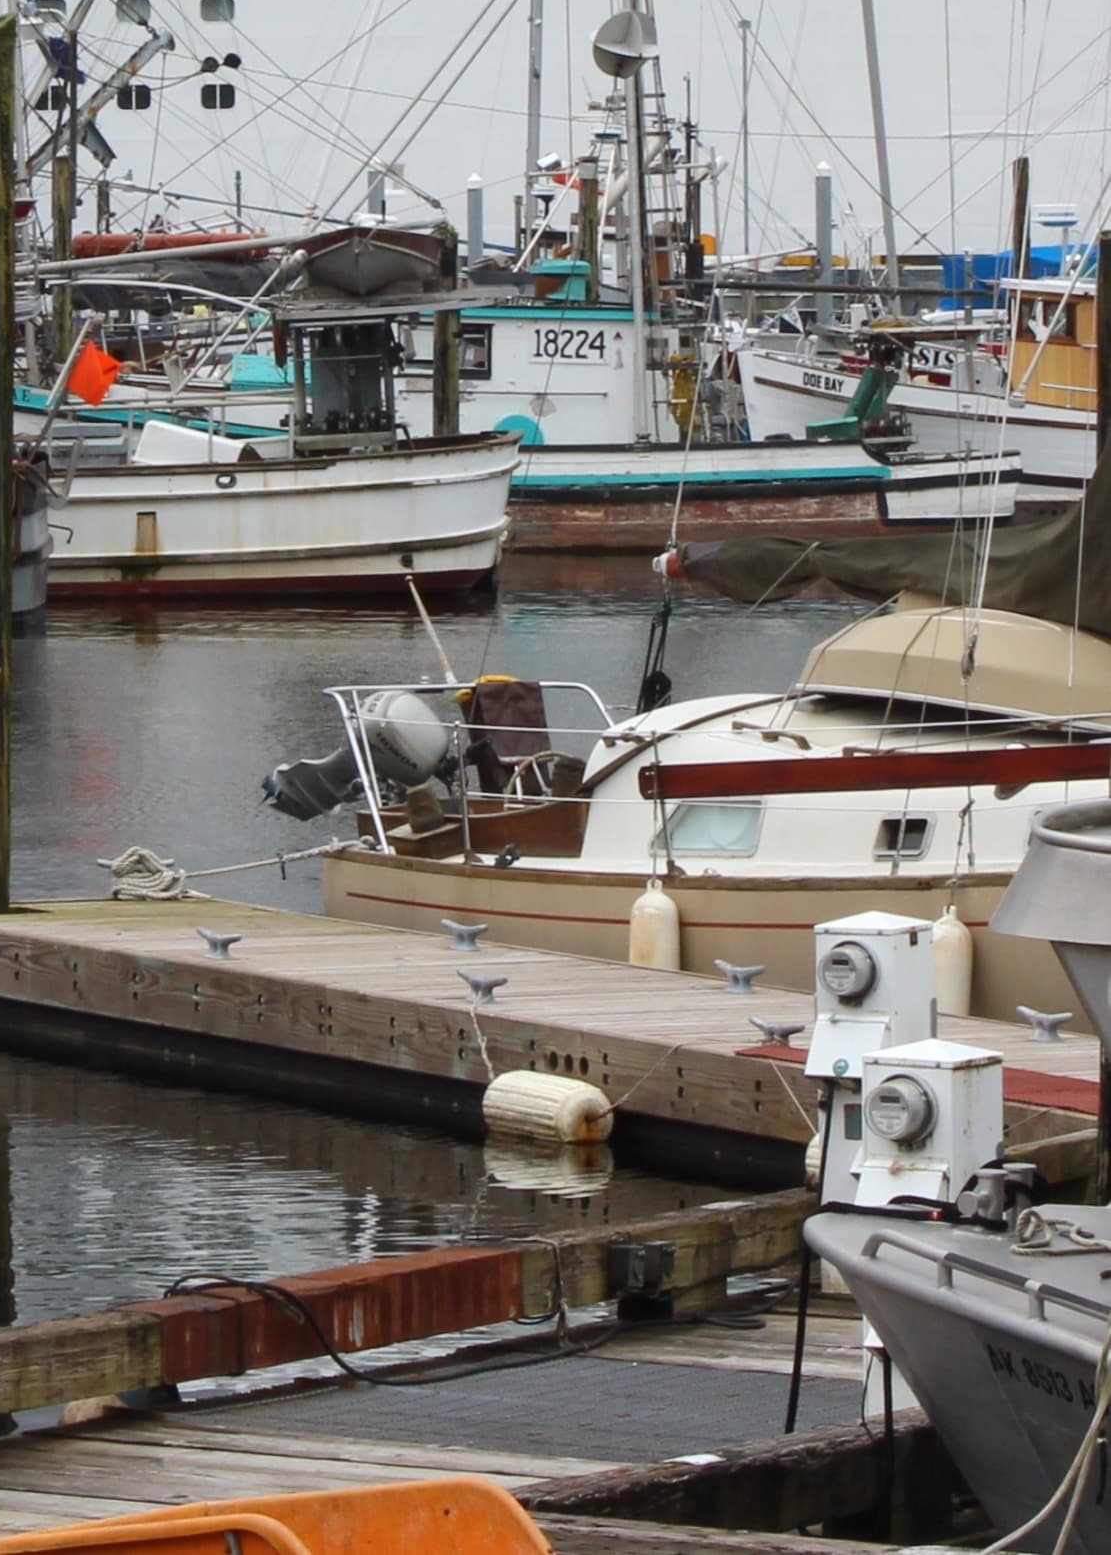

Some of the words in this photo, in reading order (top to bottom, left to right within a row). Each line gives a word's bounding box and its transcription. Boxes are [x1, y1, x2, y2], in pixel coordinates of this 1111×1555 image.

[533, 328, 607, 359] 18224
[802, 371, 823, 389] DOE
[824, 376, 845, 393] BAY
